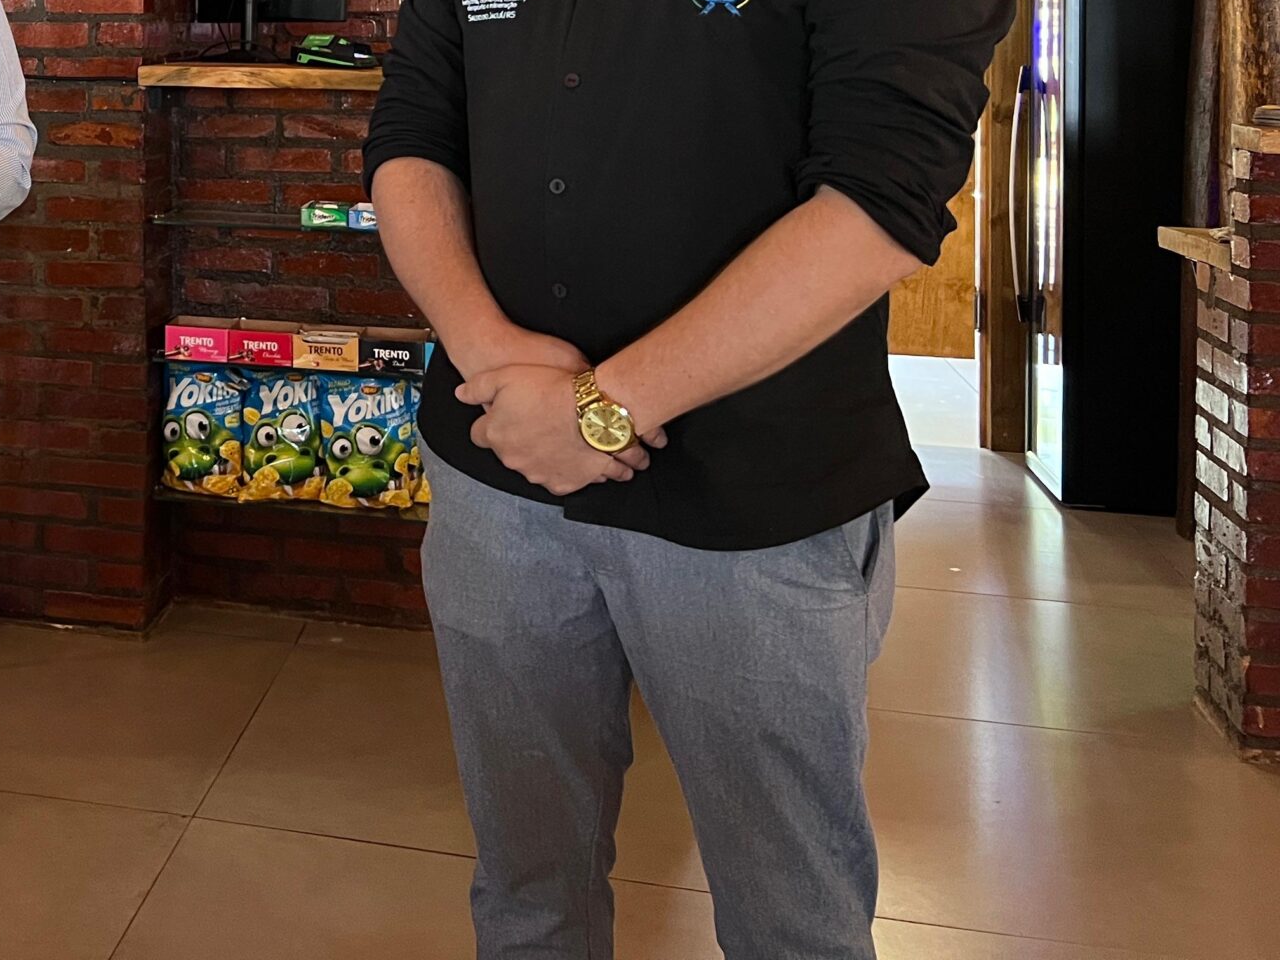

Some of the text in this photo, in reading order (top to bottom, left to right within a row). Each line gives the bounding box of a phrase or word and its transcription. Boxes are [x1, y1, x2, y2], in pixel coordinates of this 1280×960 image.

[179, 335, 214, 347] TRENTO
[243, 340, 279, 352] TRENTO
[308, 345, 343, 356] TRENTO
[372, 348, 410, 361] TRENTO
